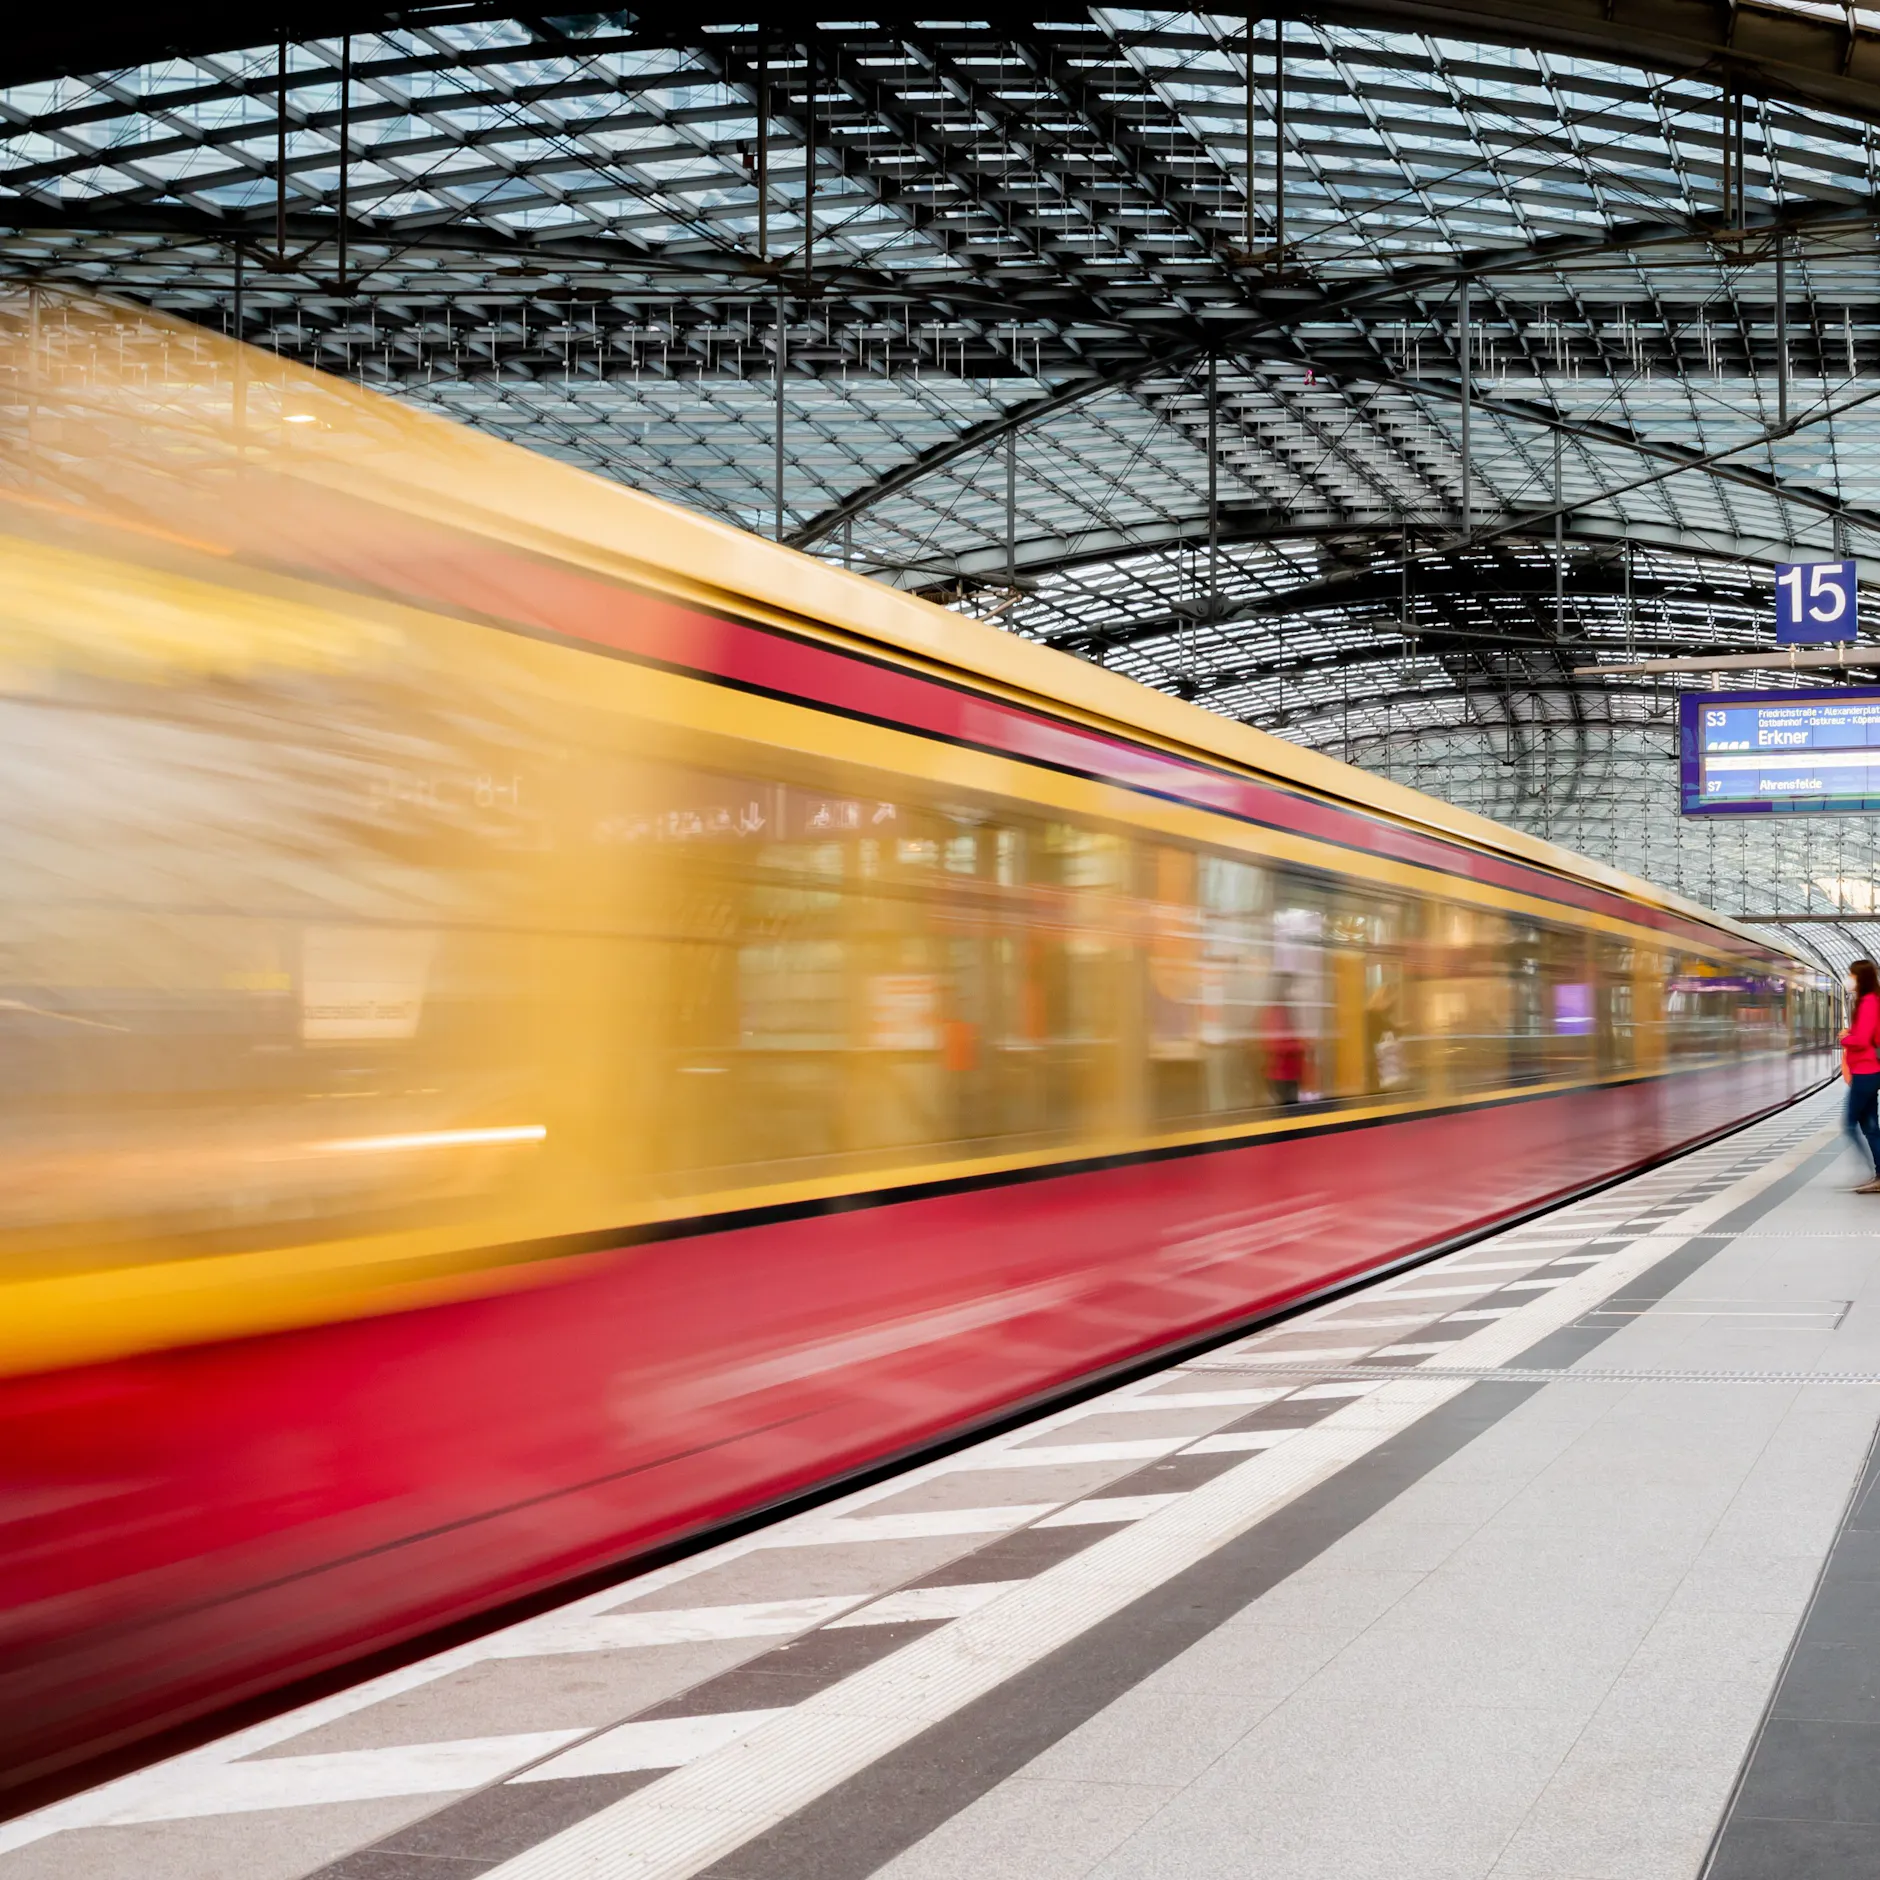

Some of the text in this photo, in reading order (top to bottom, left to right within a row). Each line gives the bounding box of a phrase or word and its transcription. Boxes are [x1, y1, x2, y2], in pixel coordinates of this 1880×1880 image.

[1778, 564, 1846, 622] 15
[1759, 707, 1817, 718] Friedrichstraße
[1706, 711, 1726, 727] S3
[1759, 717, 1803, 728] Ostbahnhof
[1809, 717, 1845, 726] Ostkreuz
[1759, 730, 1808, 745] Erkner
[1707, 780, 1722, 792] S7
[1759, 779, 1822, 790] Ahrensfelde
